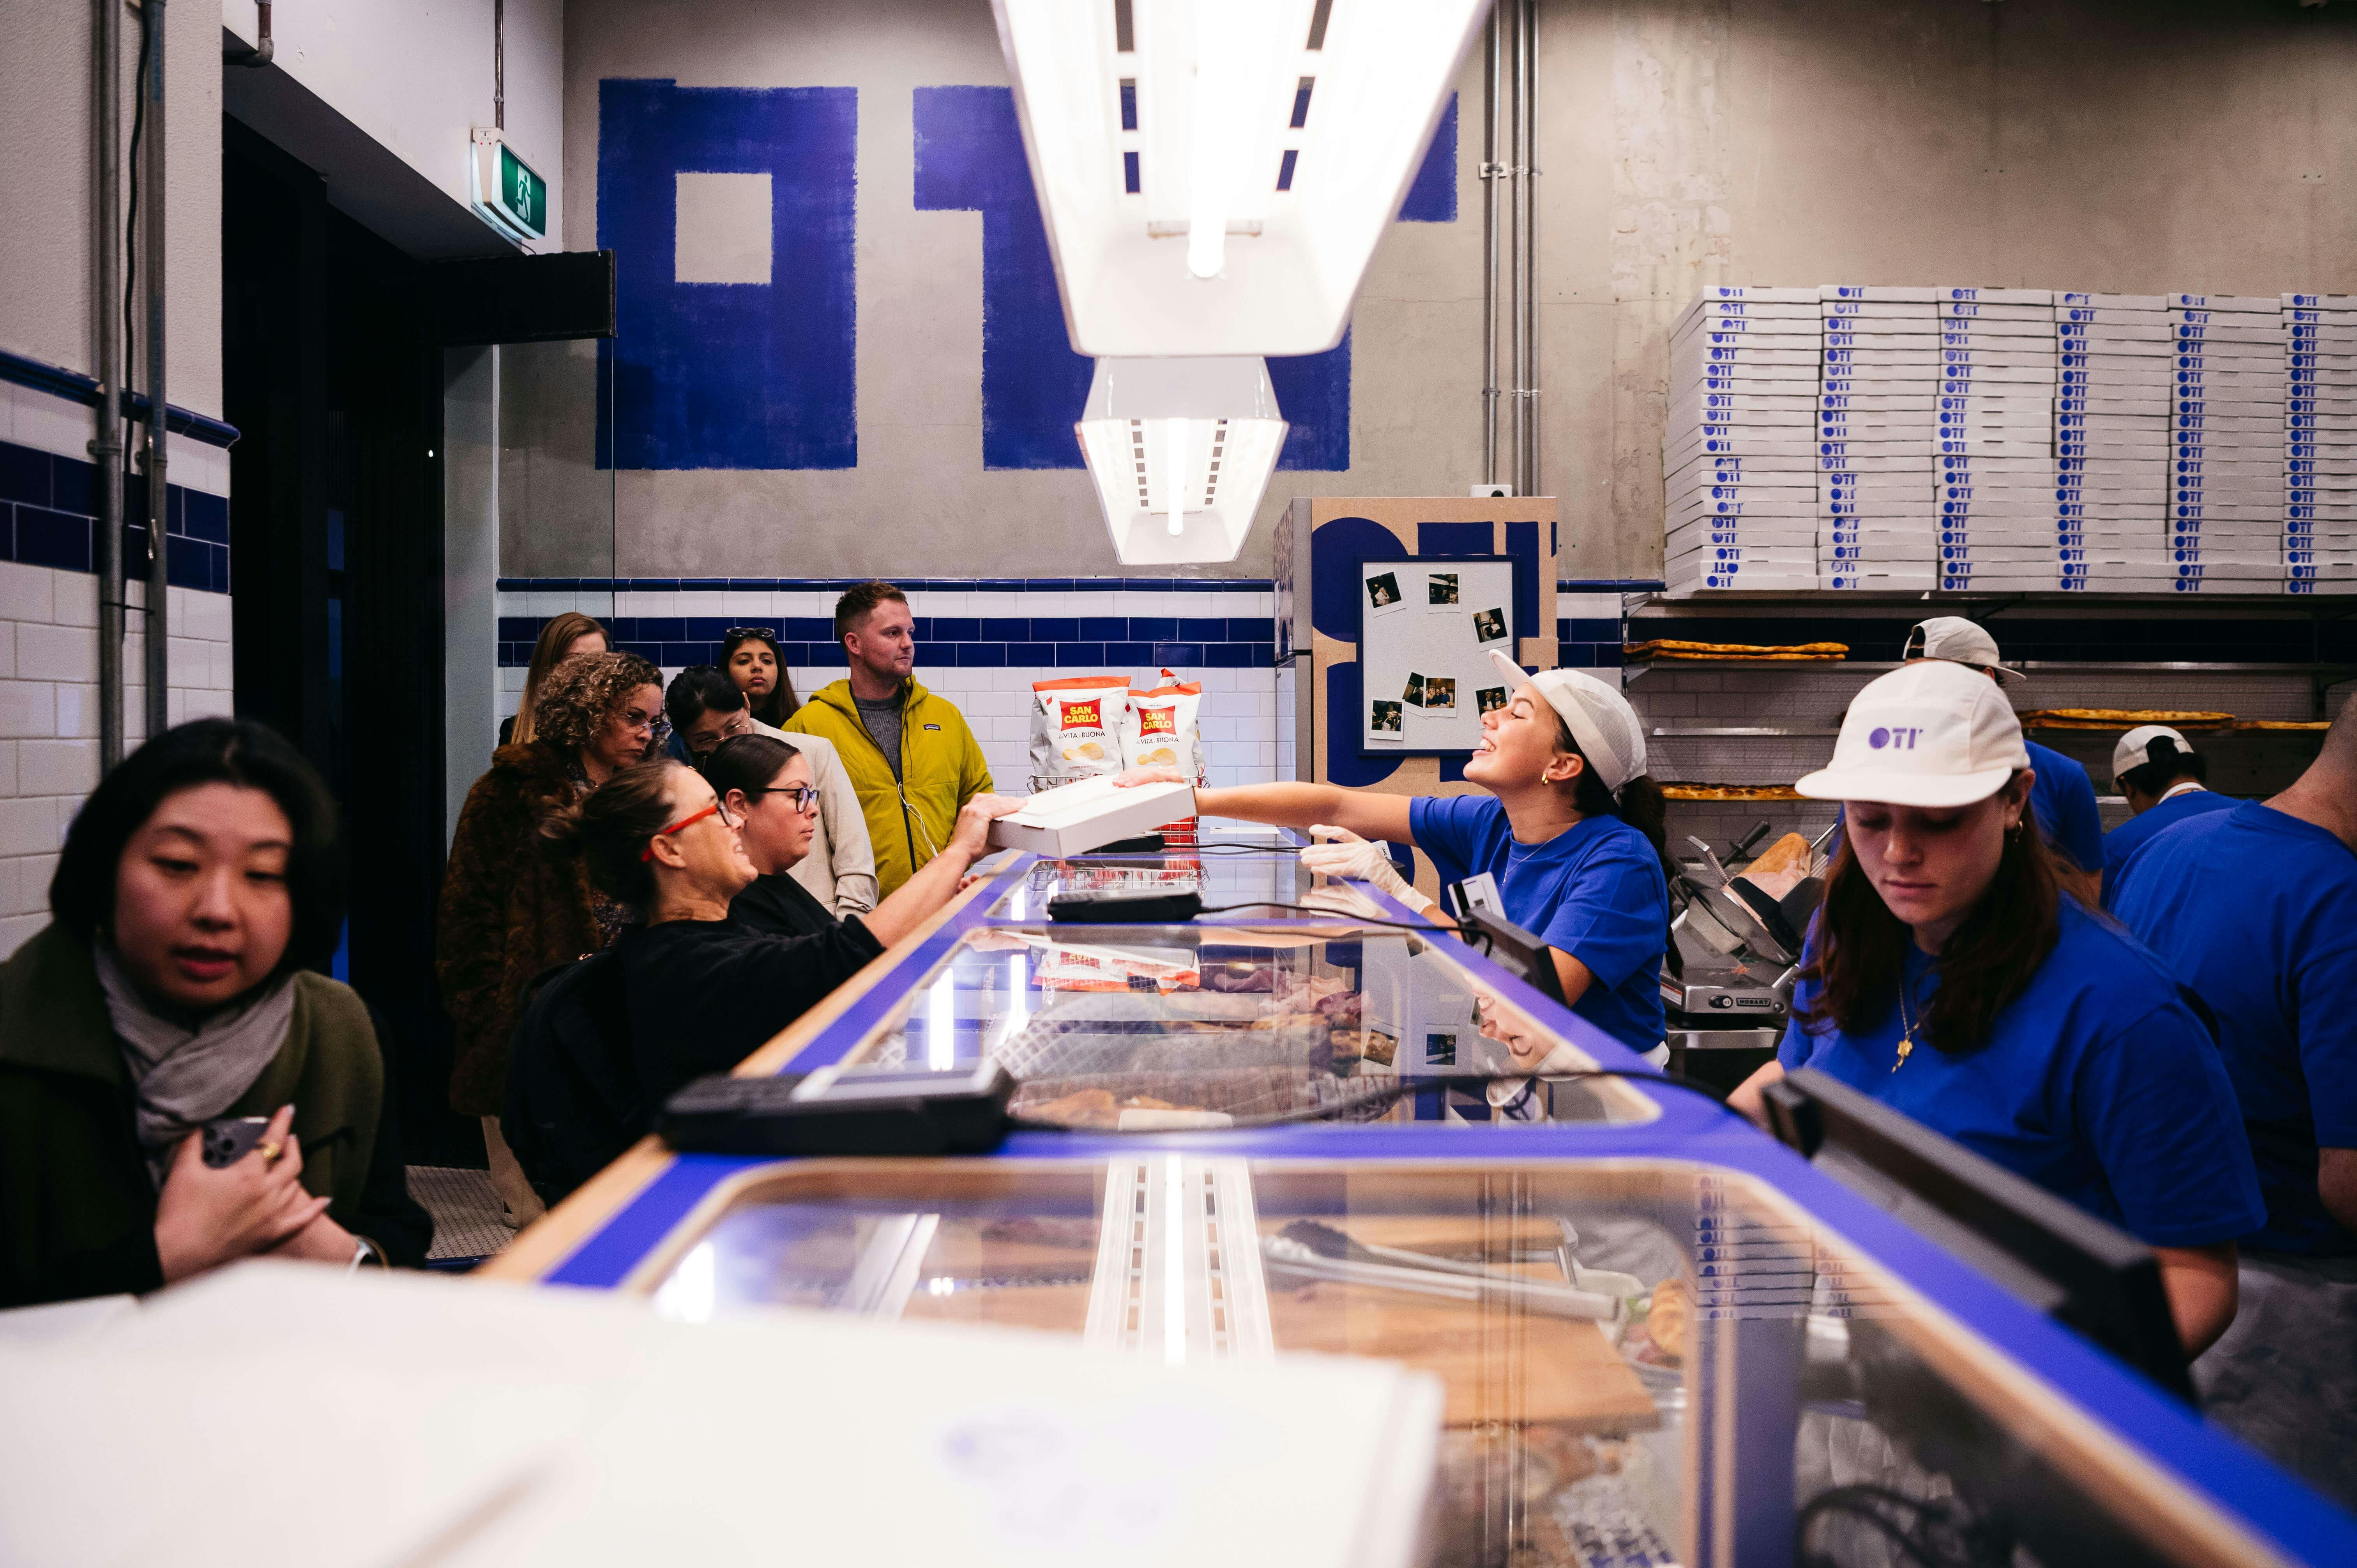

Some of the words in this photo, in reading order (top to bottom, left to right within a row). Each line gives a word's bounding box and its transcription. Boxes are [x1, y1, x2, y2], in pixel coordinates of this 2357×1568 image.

[1069, 706, 1092, 715] SAN
[1064, 714, 1098, 724] CARLO
[1145, 713, 1166, 721] SAN
[1143, 720, 1172, 730] CARLO
